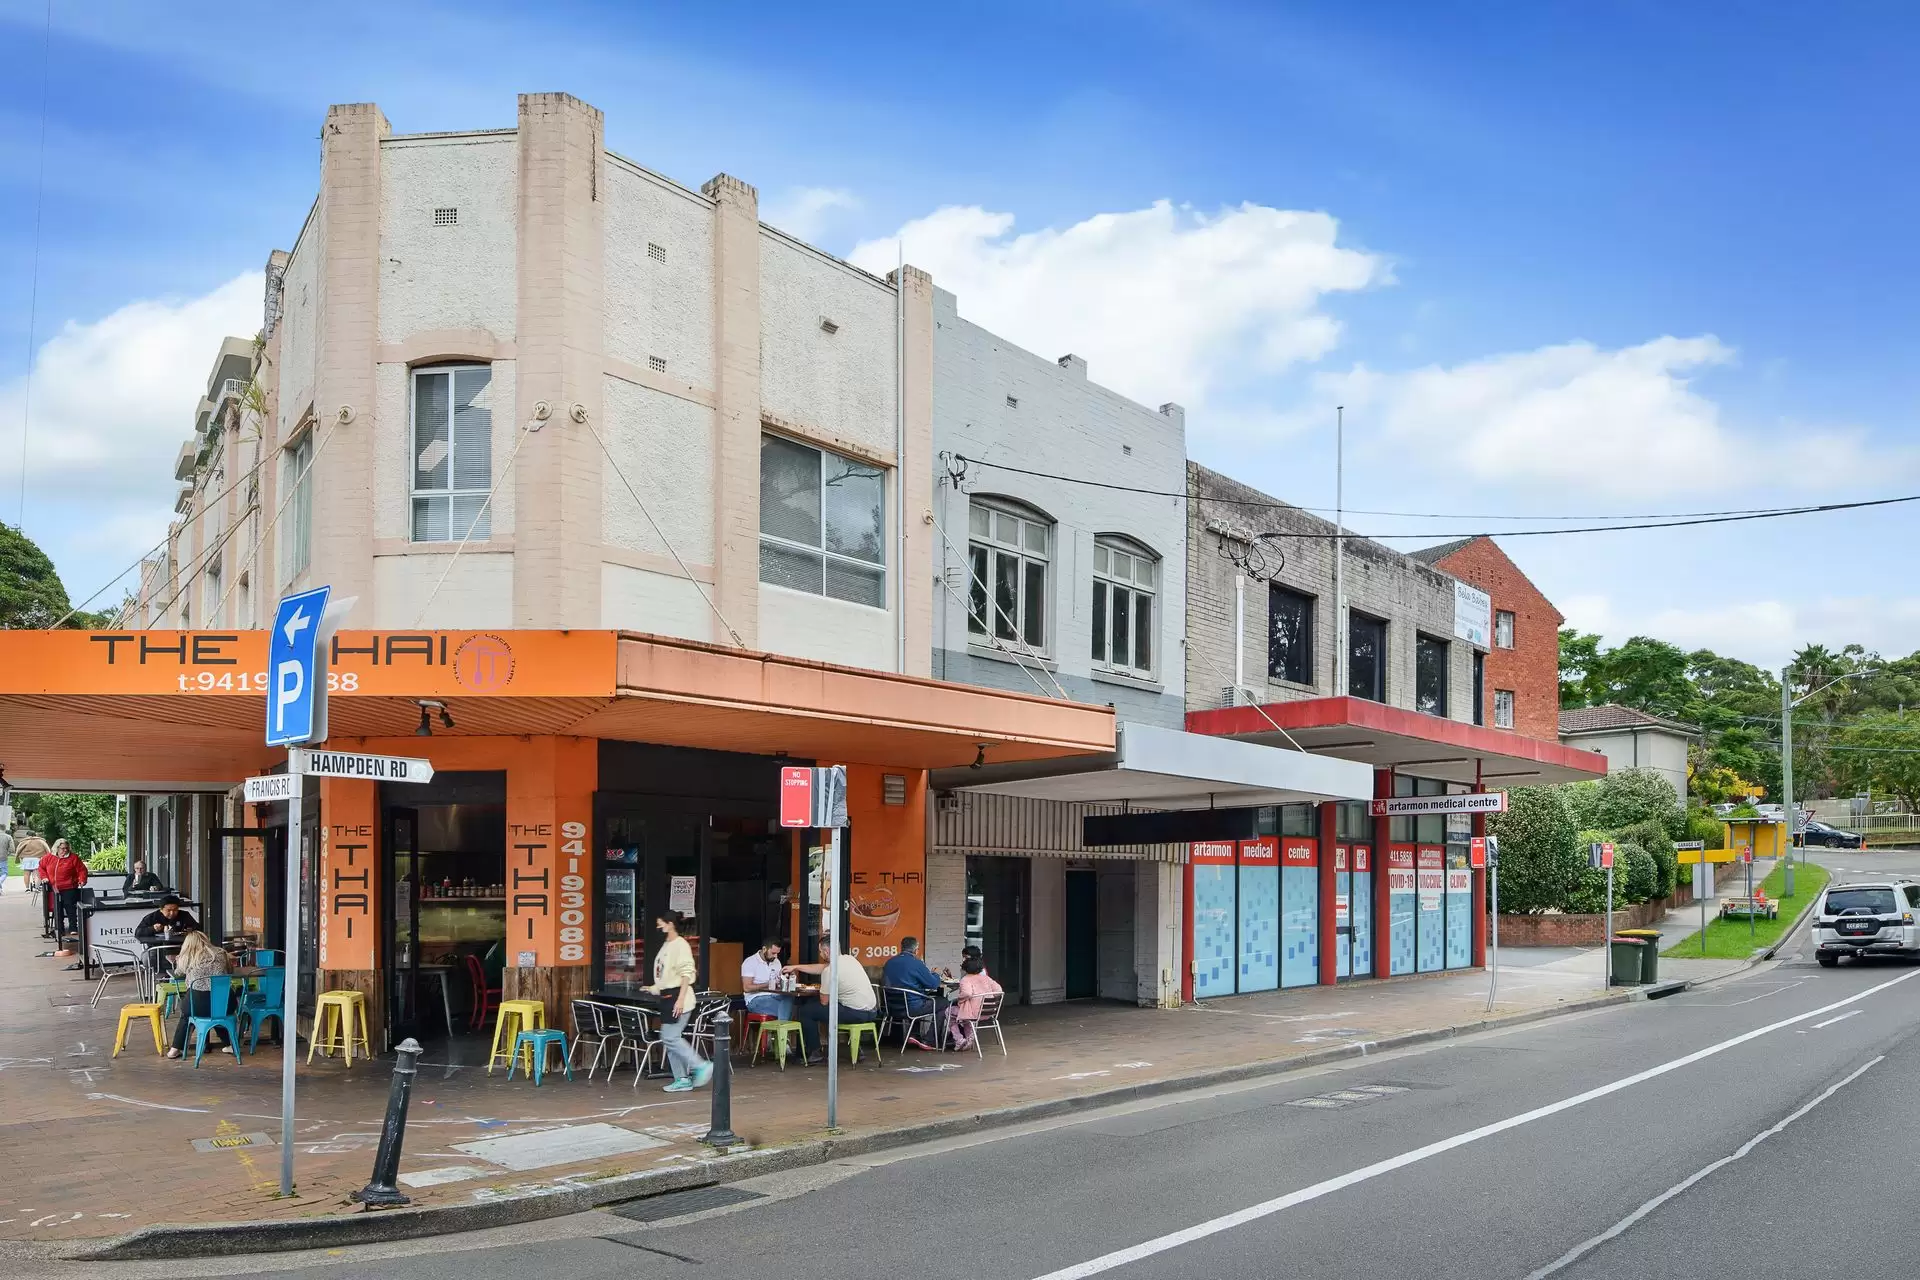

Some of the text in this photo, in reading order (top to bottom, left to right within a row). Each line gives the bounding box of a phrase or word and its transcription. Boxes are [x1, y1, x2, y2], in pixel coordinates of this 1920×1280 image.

[90, 635, 447, 666] THE HAI
[485, 633, 513, 655] LOCAL
[276, 659, 304, 732] P
[311, 753, 408, 778] HAMPDEN RD
[252, 778, 280, 798] FRANCIS
[784, 779, 809, 787] STOPPING
[1389, 797, 1498, 811] artarmon medical centre
[332, 825, 372, 837] THE
[510, 824, 552, 836] THE
[1193, 842, 1310, 860] artarmon medical centre
[1390, 850, 1399, 861] 411
[879, 872, 924, 885] THAI
[1390, 873, 1414, 889] OVID-19
[1419, 874, 1442, 889] VACCINE
[320, 826, 329, 963] 94193088
[334, 844, 368, 939] THAI
[513, 844, 549, 940] THAI
[560, 821, 586, 961] 94193088
[100, 927, 134, 936] INTER
[866, 945, 898, 958] 3088
